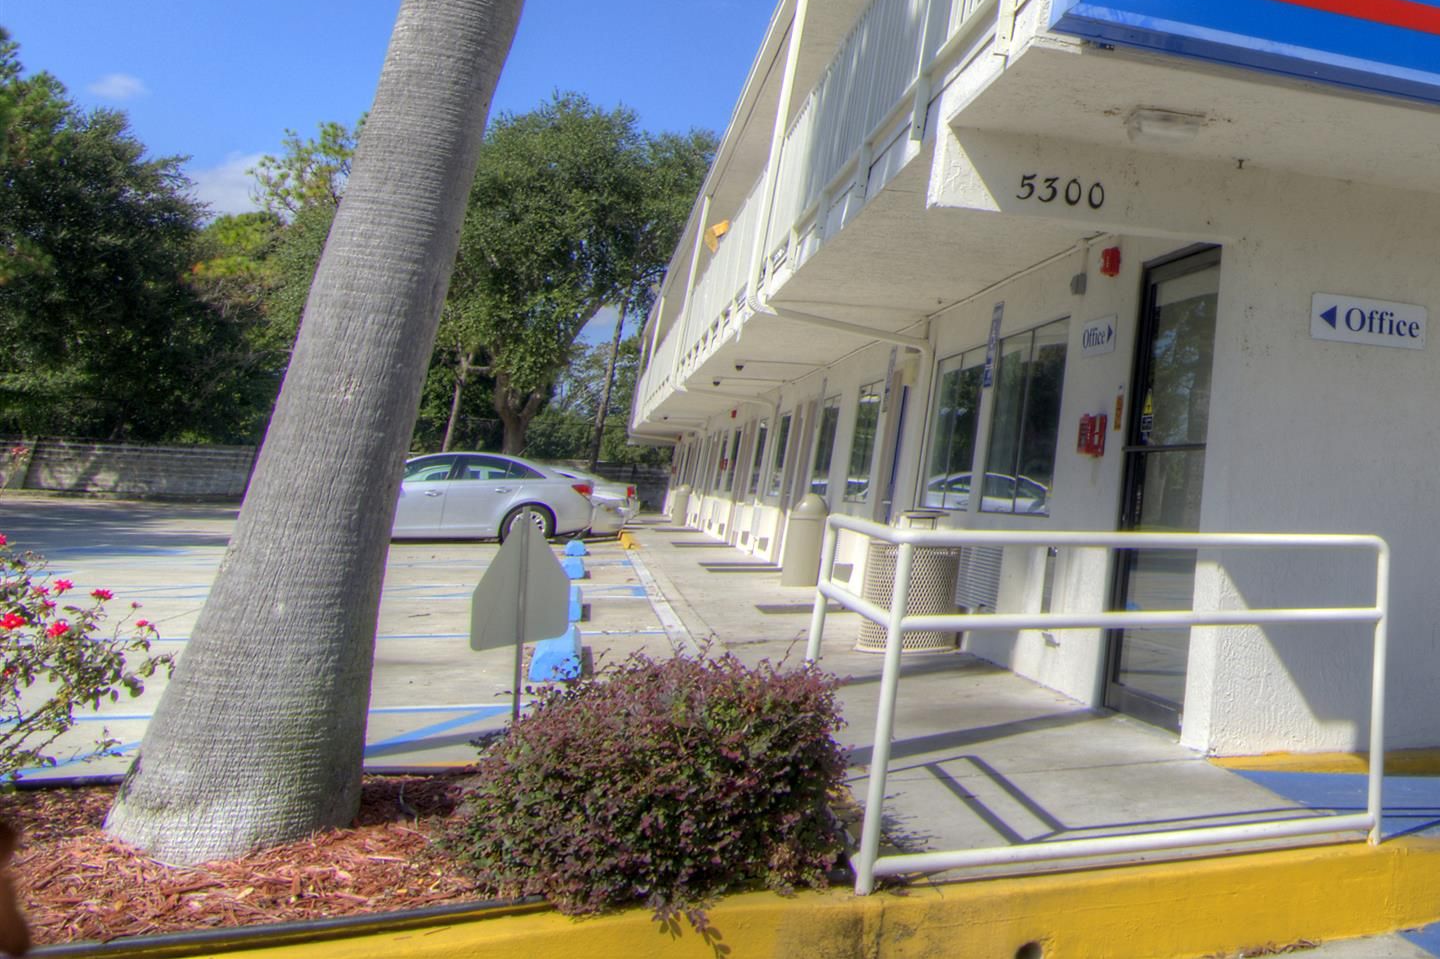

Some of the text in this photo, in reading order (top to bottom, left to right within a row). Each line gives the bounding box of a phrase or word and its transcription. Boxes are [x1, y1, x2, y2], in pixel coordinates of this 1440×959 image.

[1016, 173, 1105, 210] 5300
[1082, 327, 1106, 349] Office
[1344, 306, 1421, 338] Office
